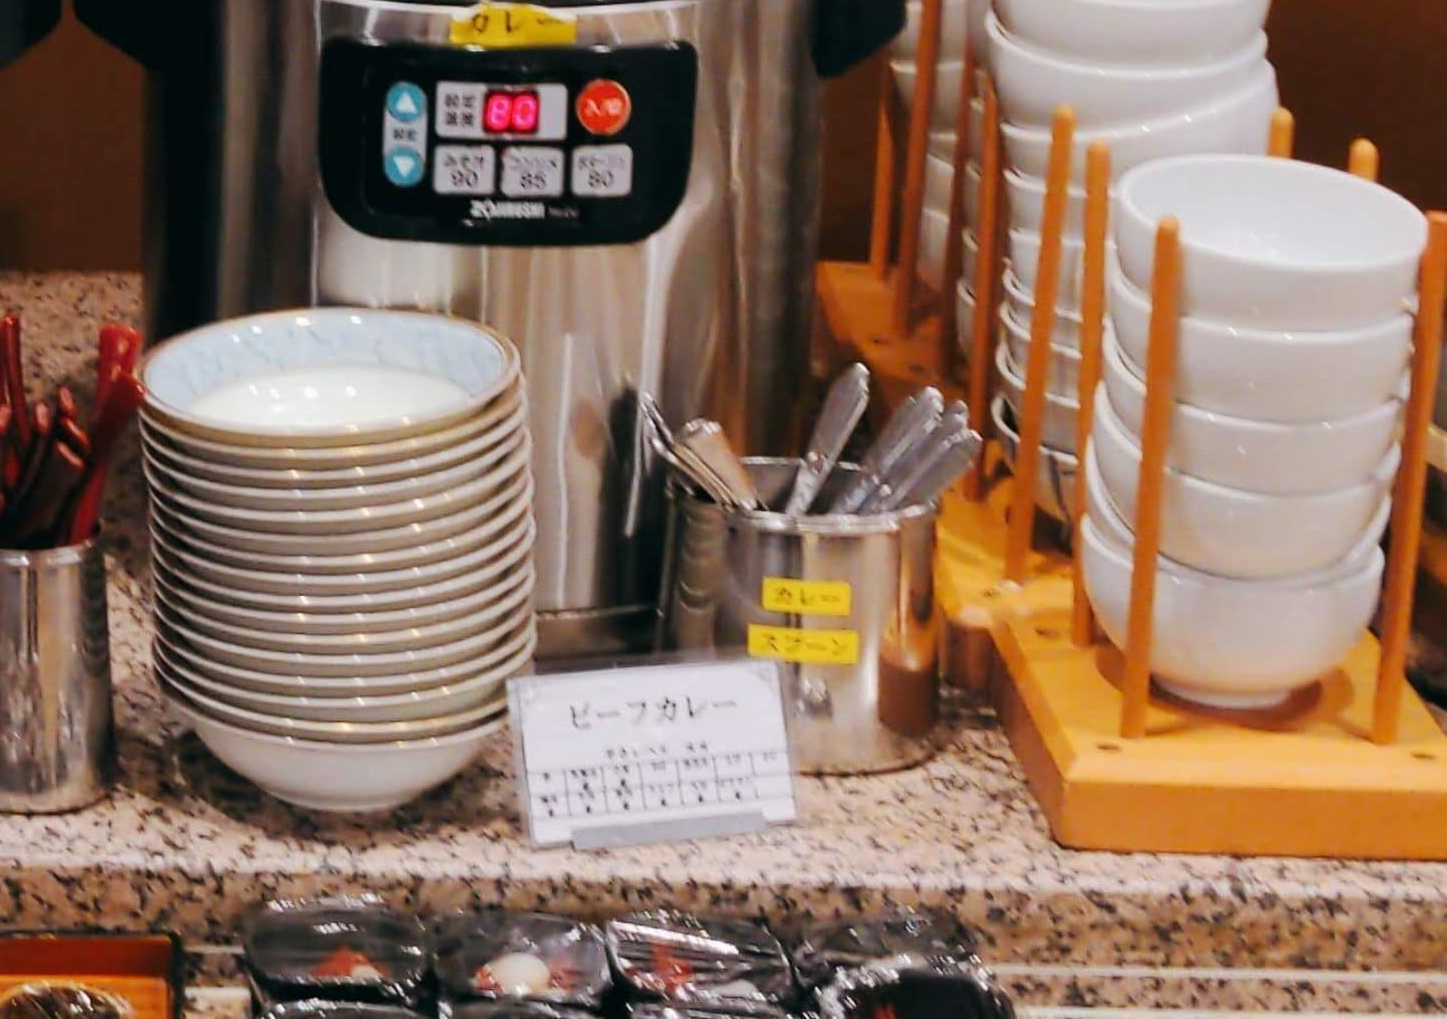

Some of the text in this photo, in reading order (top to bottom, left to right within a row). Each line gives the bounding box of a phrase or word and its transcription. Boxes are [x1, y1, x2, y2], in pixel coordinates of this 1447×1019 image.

[486, 93, 540, 130] 80
[569, 694, 737, 730] ビーフカレー
